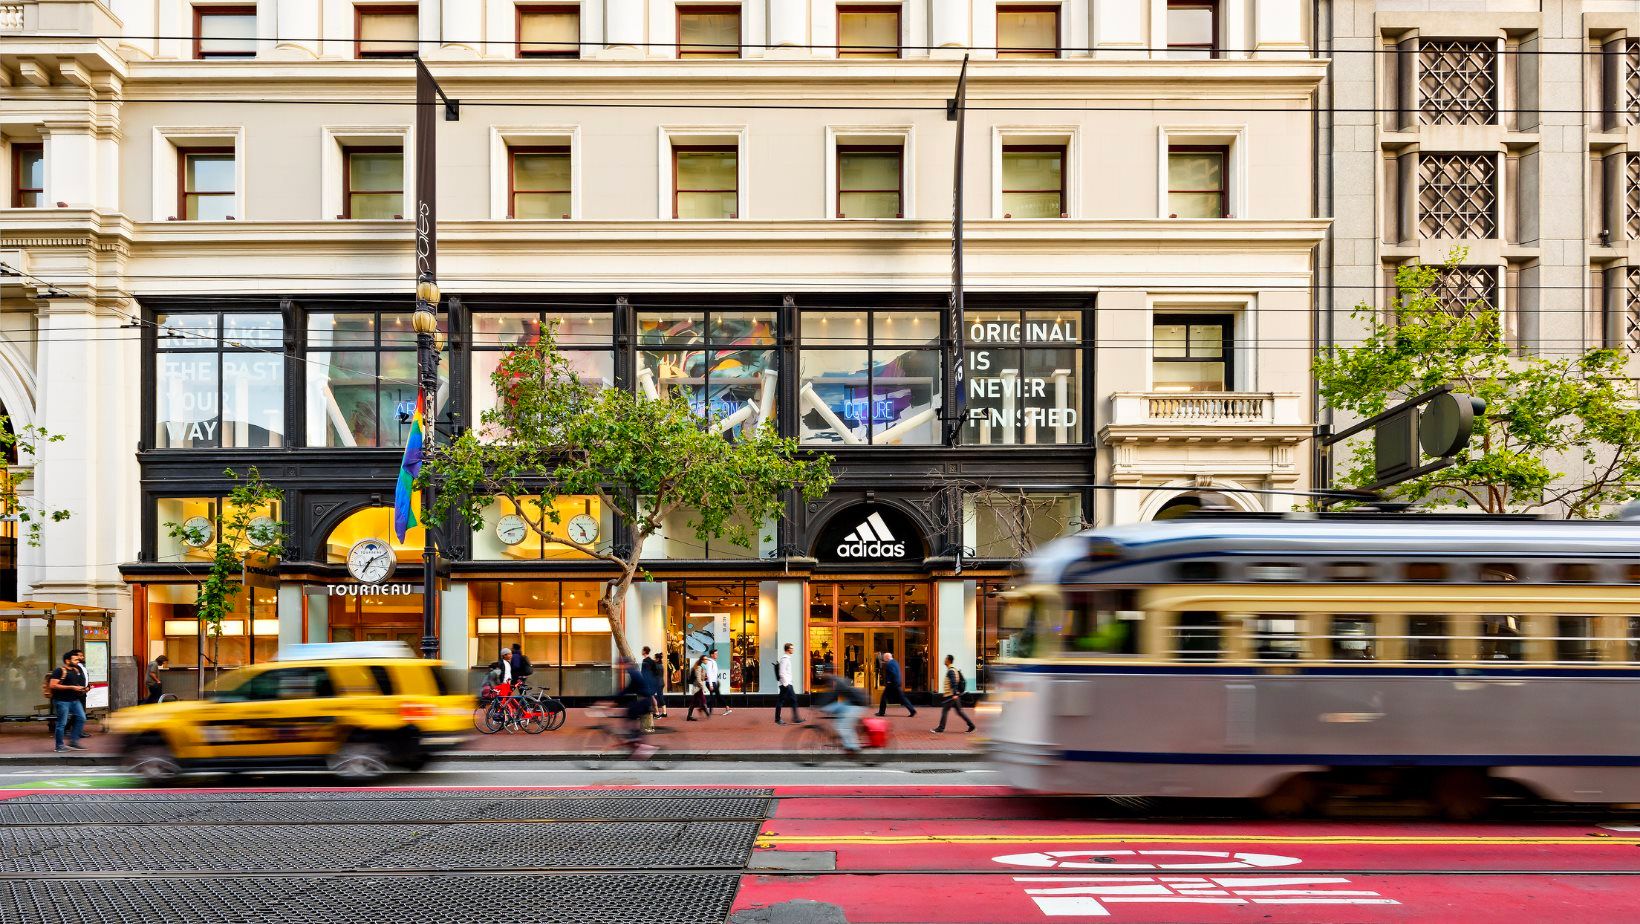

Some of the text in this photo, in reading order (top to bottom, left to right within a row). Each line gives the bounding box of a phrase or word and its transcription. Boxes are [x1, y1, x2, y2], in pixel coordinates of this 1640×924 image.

[970, 322, 1077, 343] ORIGINAL
[970, 351, 990, 371] IS
[970, 378, 1046, 398] NEVER
[166, 422, 219, 441] WAY
[836, 540, 905, 557] adidas
[327, 584, 412, 596] TOURNEAU
